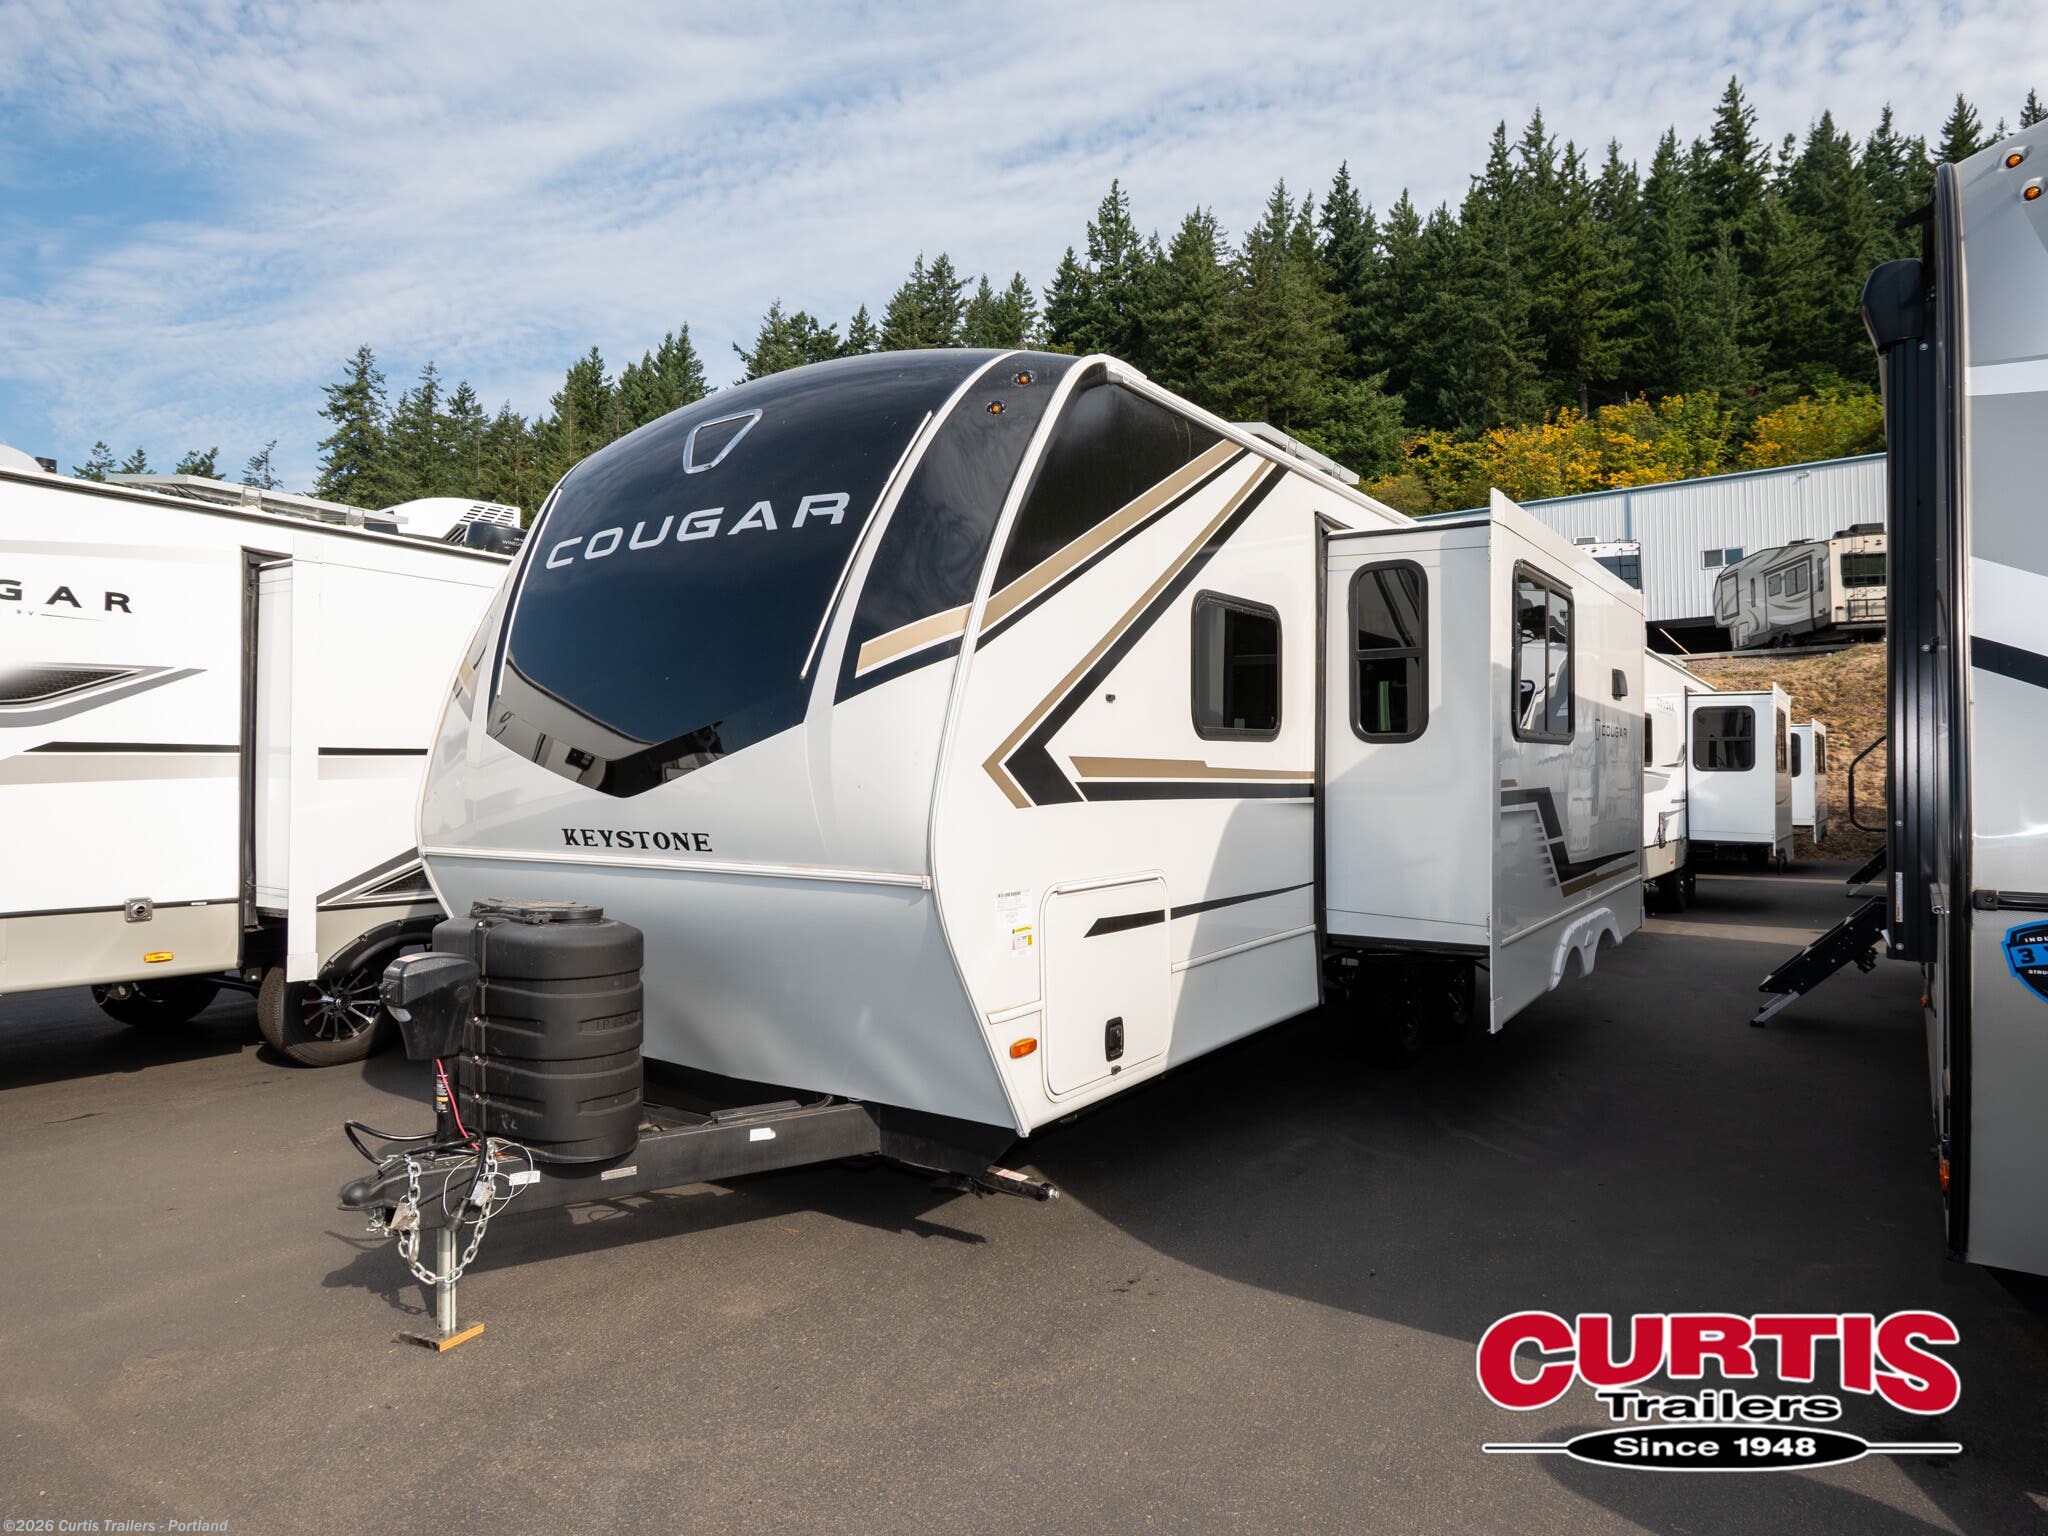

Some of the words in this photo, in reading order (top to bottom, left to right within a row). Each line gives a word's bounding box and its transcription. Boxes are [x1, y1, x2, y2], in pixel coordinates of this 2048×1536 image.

[545, 492, 850, 570] COUGAR
[1601, 724, 1628, 738] COUGAR
[561, 828, 713, 852] KEYSTONE
[2017, 947, 2036, 964] 3
